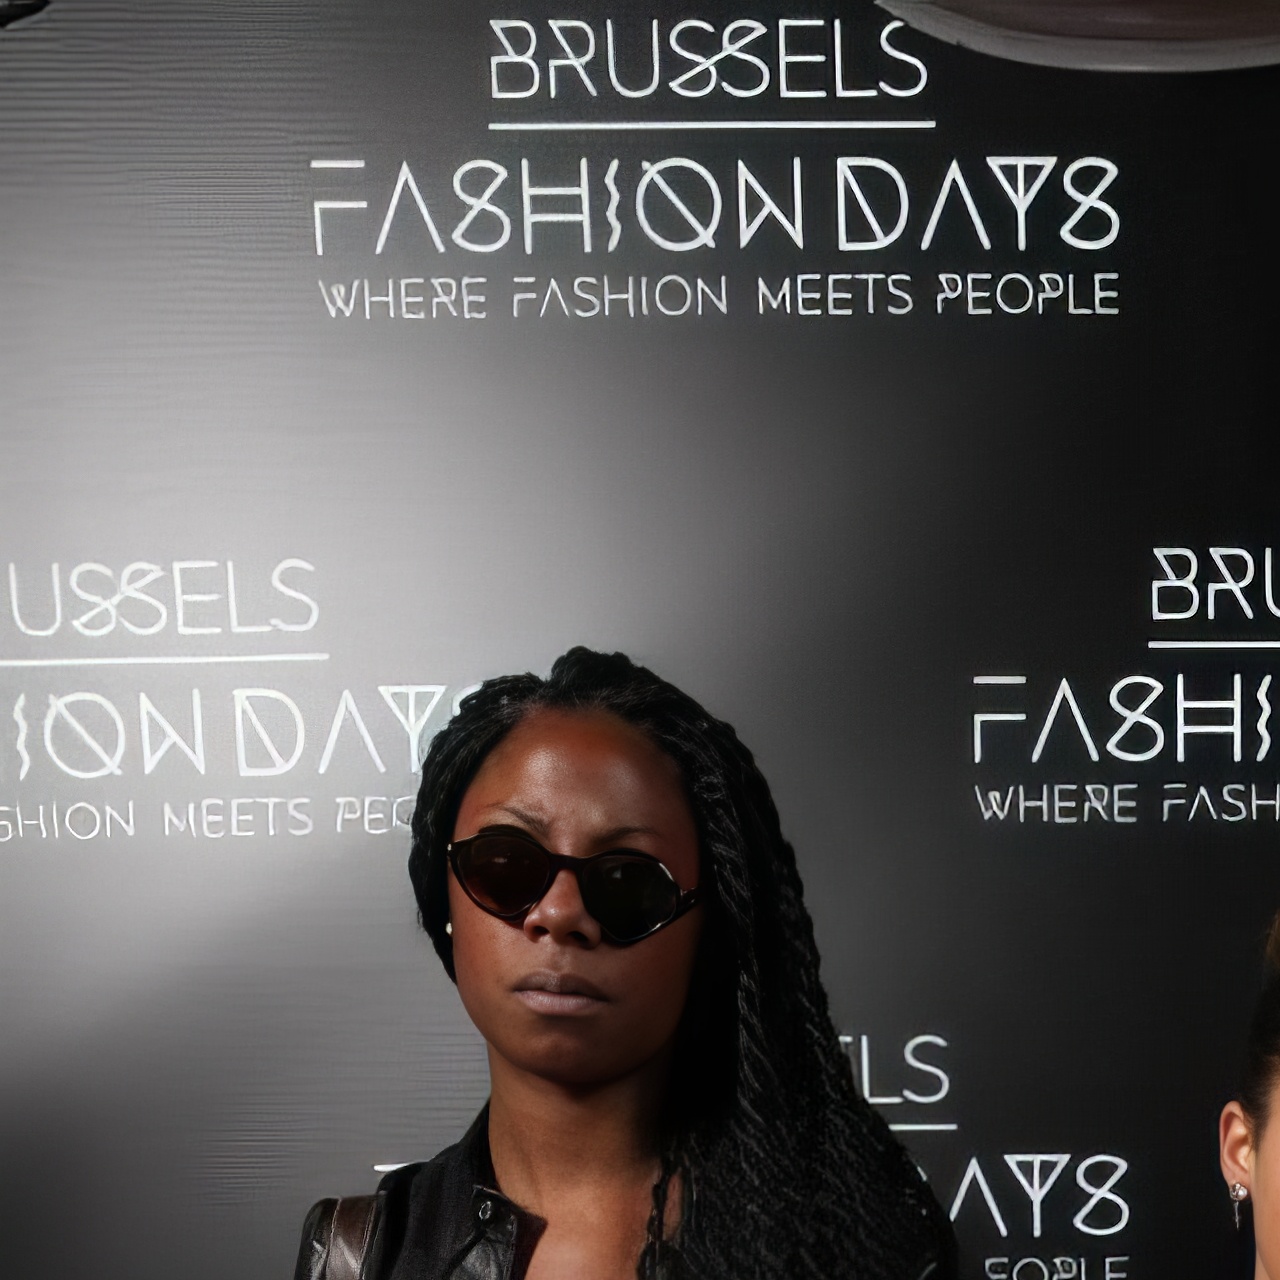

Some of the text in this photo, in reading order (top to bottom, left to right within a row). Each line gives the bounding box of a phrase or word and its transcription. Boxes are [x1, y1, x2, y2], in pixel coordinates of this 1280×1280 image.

[489, 18, 928, 99] BRUSSELS
[310, 155, 1120, 256] FASHION DAYS
[318, 272, 1120, 320] WHERE FASHION MEETS PEOPLE
[231, 683, 485, 778] DAY
[163, 797, 313, 839] MEETS
[974, 783, 1138, 824] WHERE
